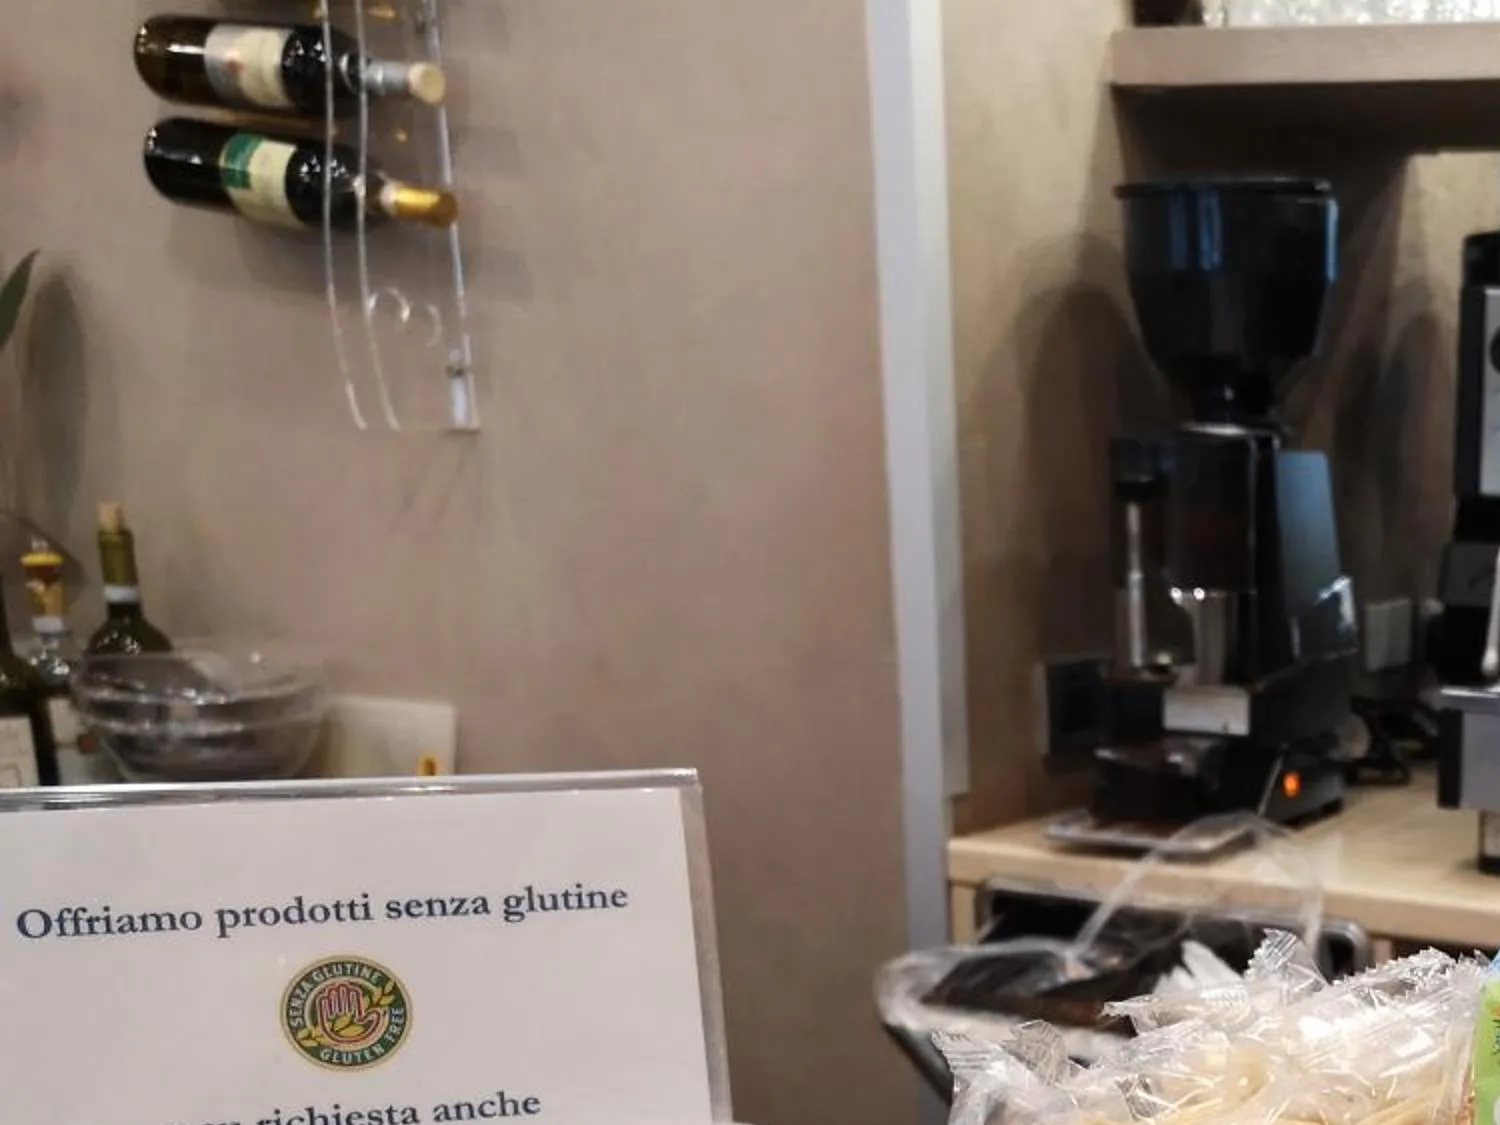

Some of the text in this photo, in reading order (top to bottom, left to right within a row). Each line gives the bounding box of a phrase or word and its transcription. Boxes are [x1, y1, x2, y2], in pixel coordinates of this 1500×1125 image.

[16, 883, 629, 940] Offriamo prodotti senza glutine
[289, 963, 383, 1028] SENZA GLUTINE
[319, 1007, 405, 1065] GLUTEN FREE
[432, 1091, 542, 1123] anche
